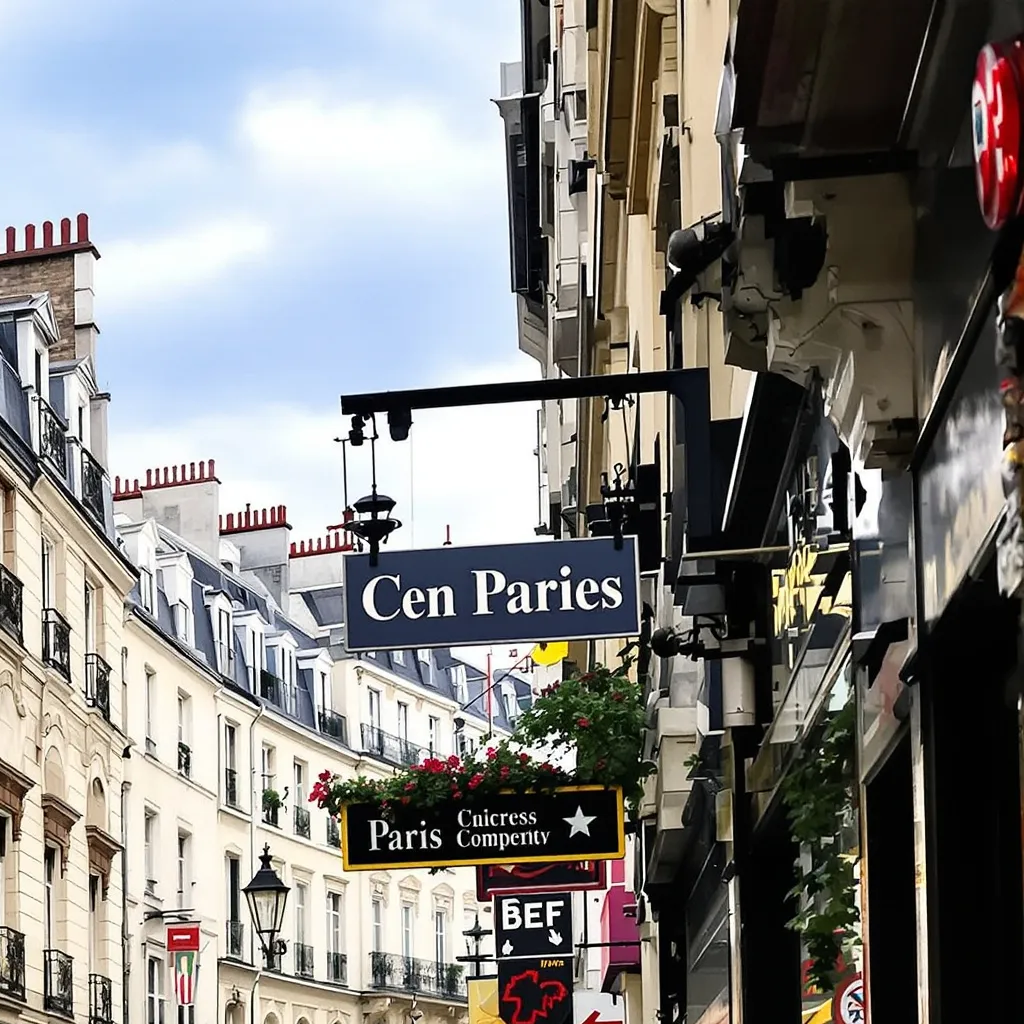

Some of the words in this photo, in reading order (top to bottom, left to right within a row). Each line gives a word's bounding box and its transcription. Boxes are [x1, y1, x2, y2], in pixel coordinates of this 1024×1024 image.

[362, 574, 456, 622] Cen
[471, 565, 623, 616] Paries
[367, 819, 443, 852] Paris
